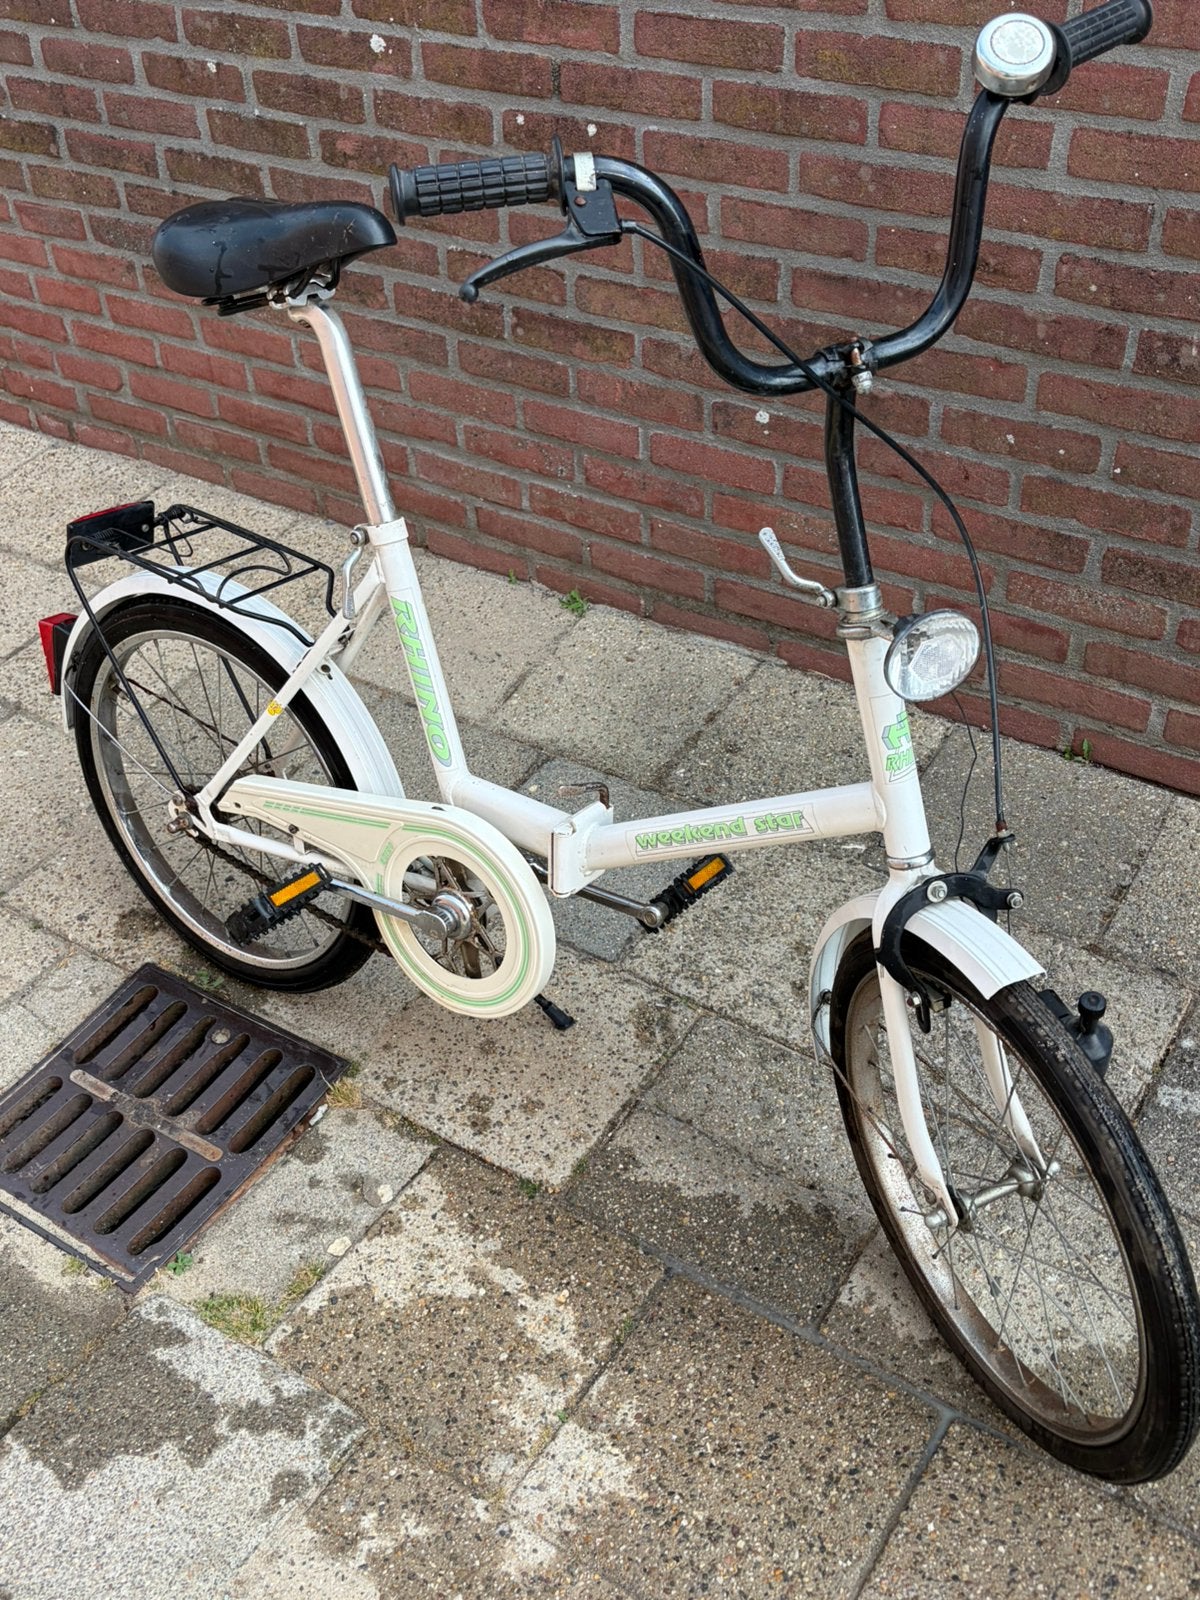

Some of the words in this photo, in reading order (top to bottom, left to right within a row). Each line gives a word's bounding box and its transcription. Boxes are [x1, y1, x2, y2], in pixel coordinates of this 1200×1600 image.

[391, 596, 452, 767] RHINO
[635, 815, 748, 850] weekend
[753, 810, 805, 834] star
